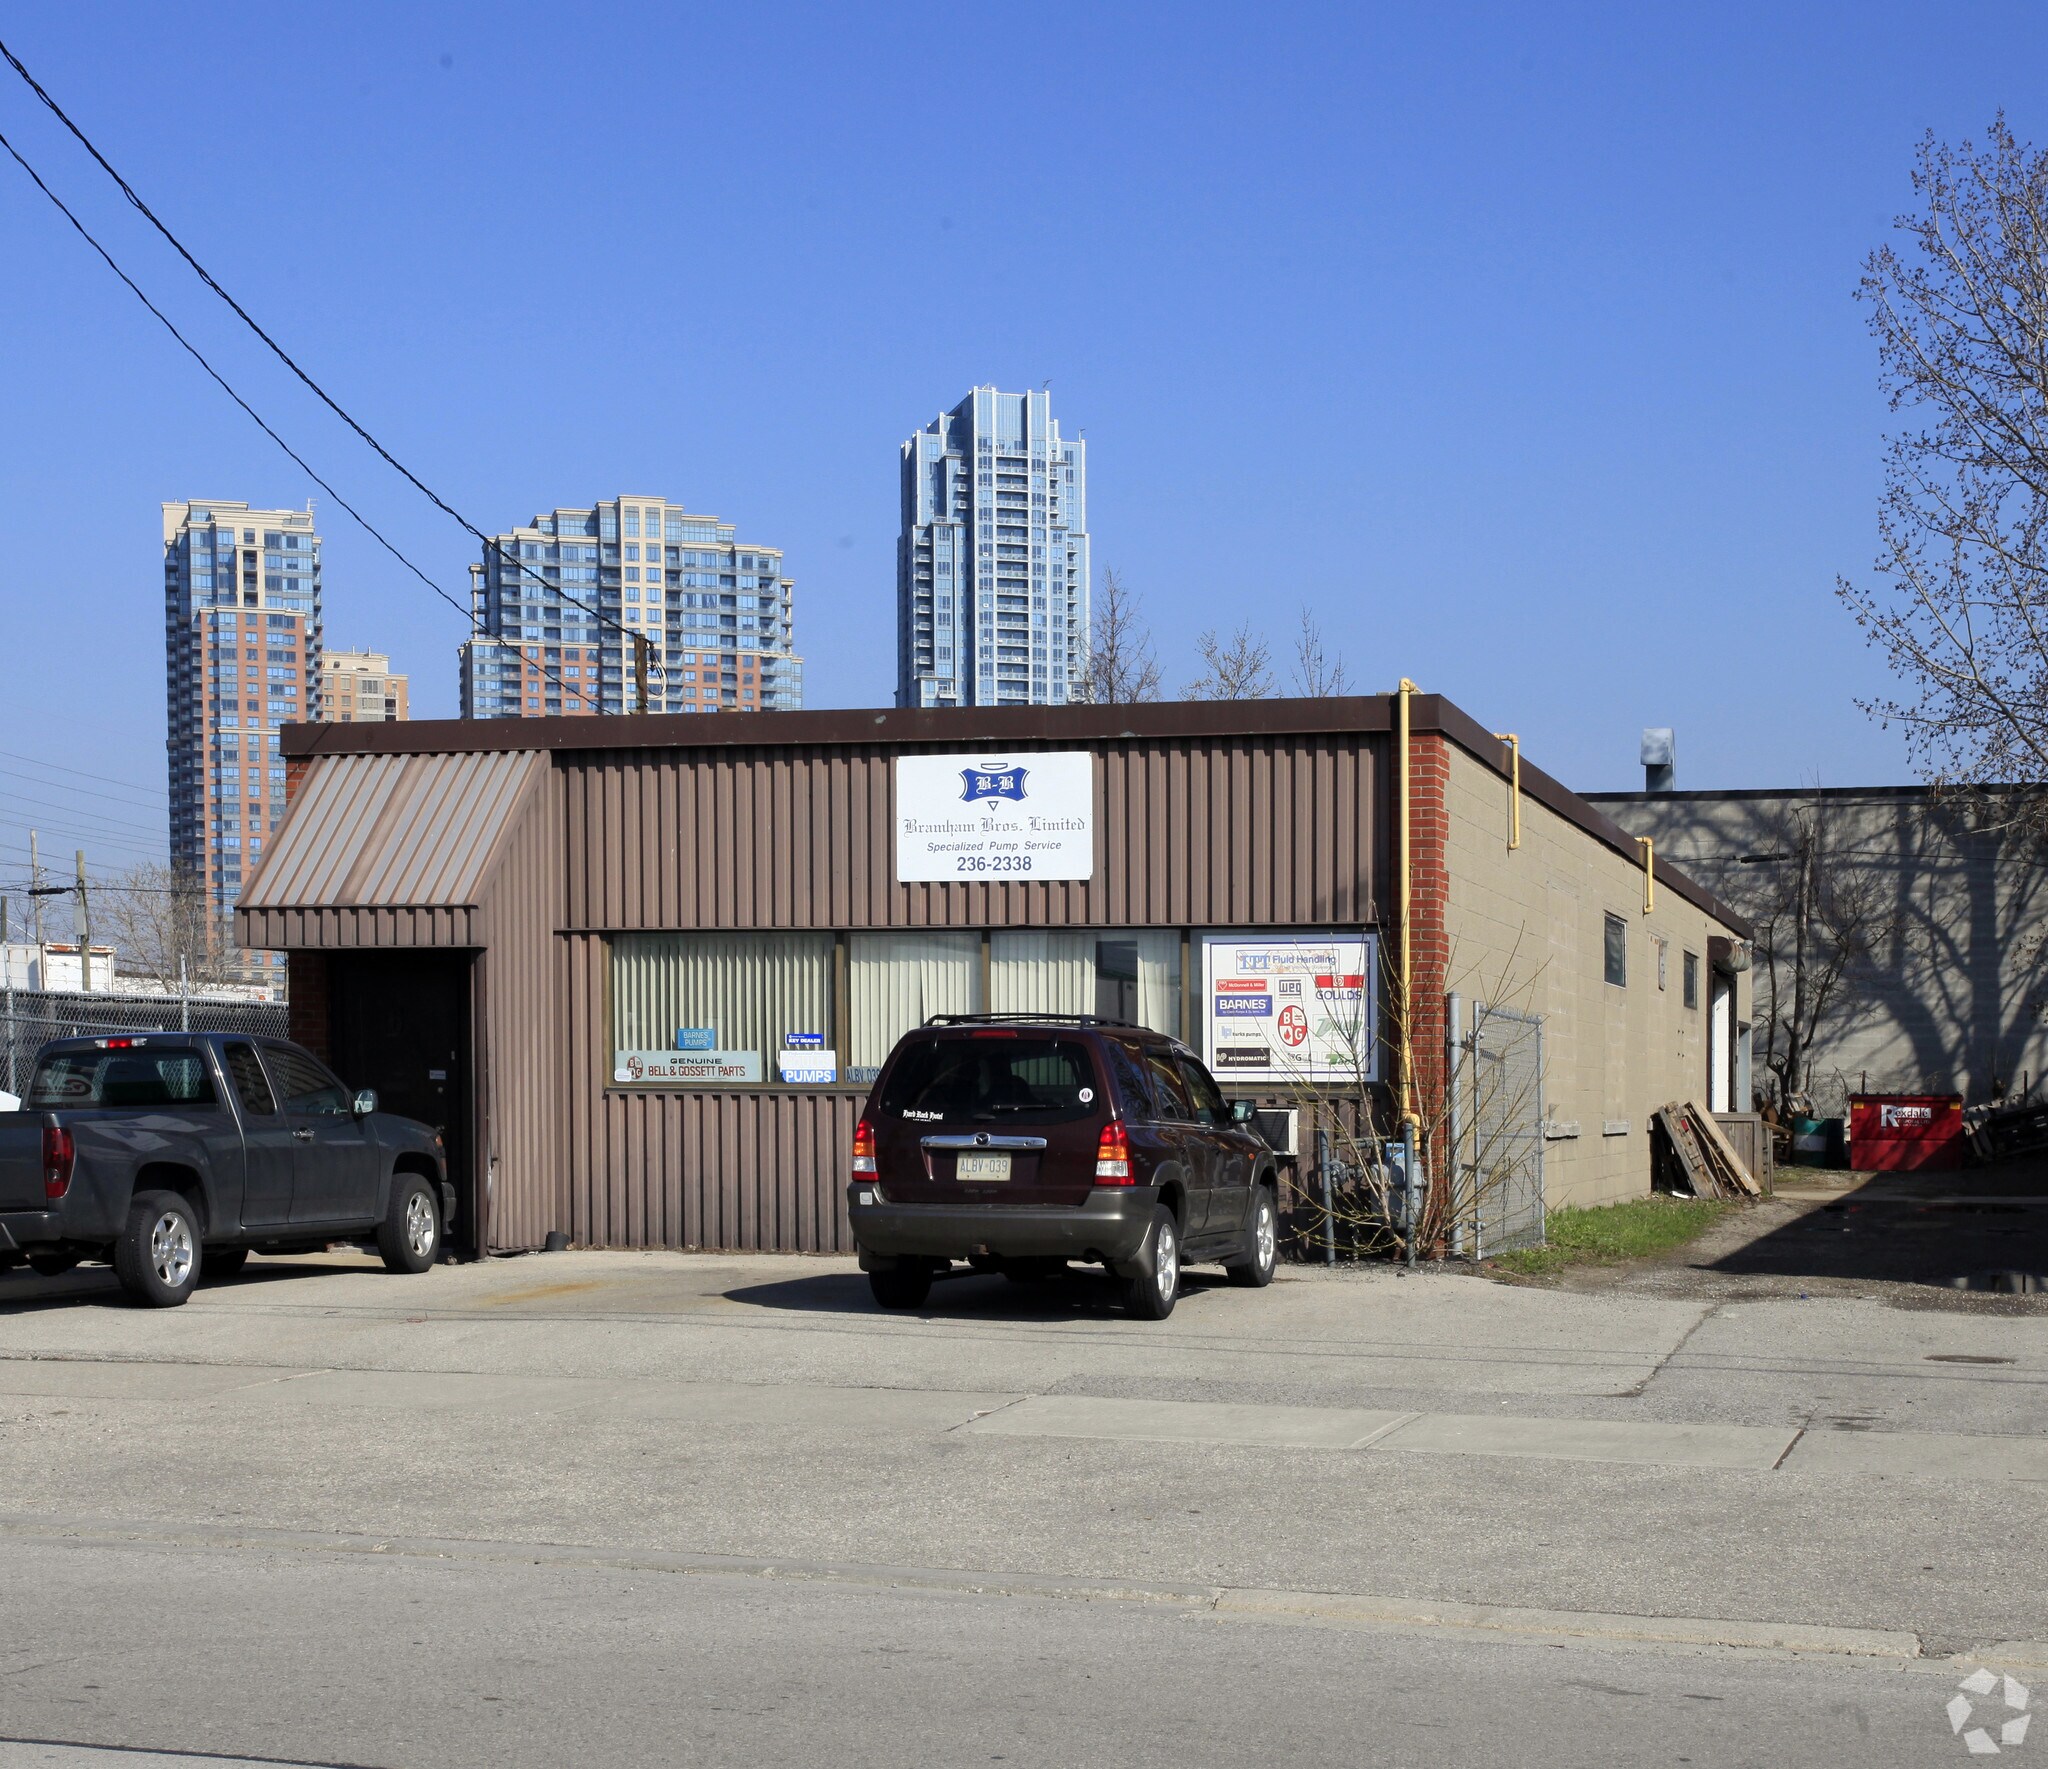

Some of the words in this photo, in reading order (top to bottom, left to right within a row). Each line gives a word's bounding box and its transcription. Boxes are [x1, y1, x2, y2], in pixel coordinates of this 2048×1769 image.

[903, 818, 975, 838] Bramham
[980, 817, 1023, 836] Bros.
[1028, 816, 1085, 835] Limited
[927, 842, 983, 853] Specialized
[989, 841, 1019, 853] Pump
[1024, 840, 1062, 851] Service
[957, 856, 1032, 871] 236-2338
[1272, 954, 1295, 964] Fluid
[1315, 990, 1362, 1000] GOULDS
[1220, 999, 1266, 1010] BARNES
[683, 1031, 708, 1039] BARNES
[648, 1066, 668, 1076] BELL
[670, 1066, 676, 1076] &
[679, 1066, 715, 1076] GOSSETT
[719, 1066, 745, 1076] PARTS
[786, 1071, 832, 1082] PUMPS
[1881, 1104, 1928, 1127] Rexdale
[960, 1159, 984, 1173] ALBV
[989, 1159, 1008, 1173] 039
